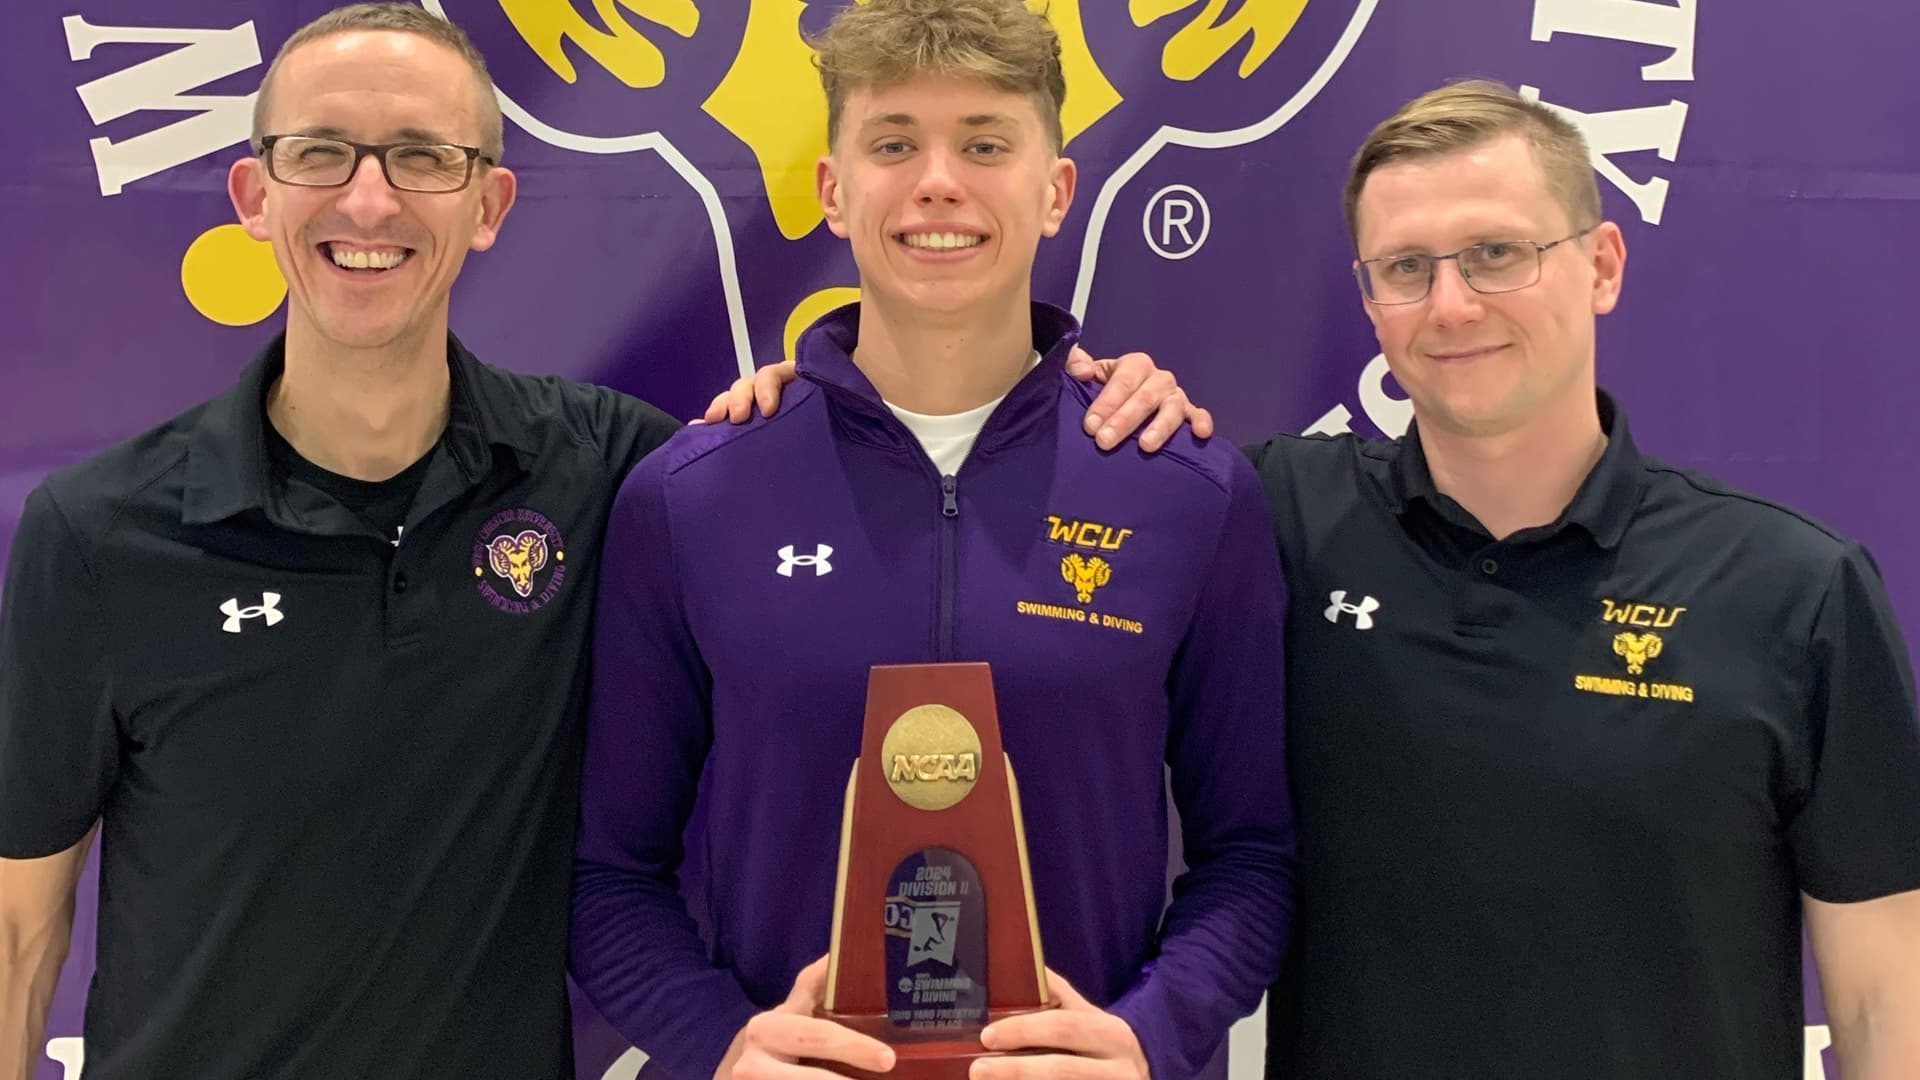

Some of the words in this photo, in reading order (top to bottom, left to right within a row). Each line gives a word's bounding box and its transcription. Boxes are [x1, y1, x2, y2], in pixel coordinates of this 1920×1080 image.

[1047, 515, 1133, 550] WCU
[478, 579, 529, 613] SWIMMING
[540, 564, 566, 603] DIVING
[1017, 600, 1086, 622] SWIMMING
[1089, 612, 1100, 625] &
[1102, 614, 1144, 634] DIVING
[1601, 599, 1688, 628] WCU
[1574, 675, 1637, 696] SWIMMING
[1637, 682, 1649, 698] &
[1650, 683, 1694, 703] DIVING
[891, 752, 976, 783] NCAA
[914, 865, 952, 881] 2024
[898, 881, 957, 897] DIVISION
